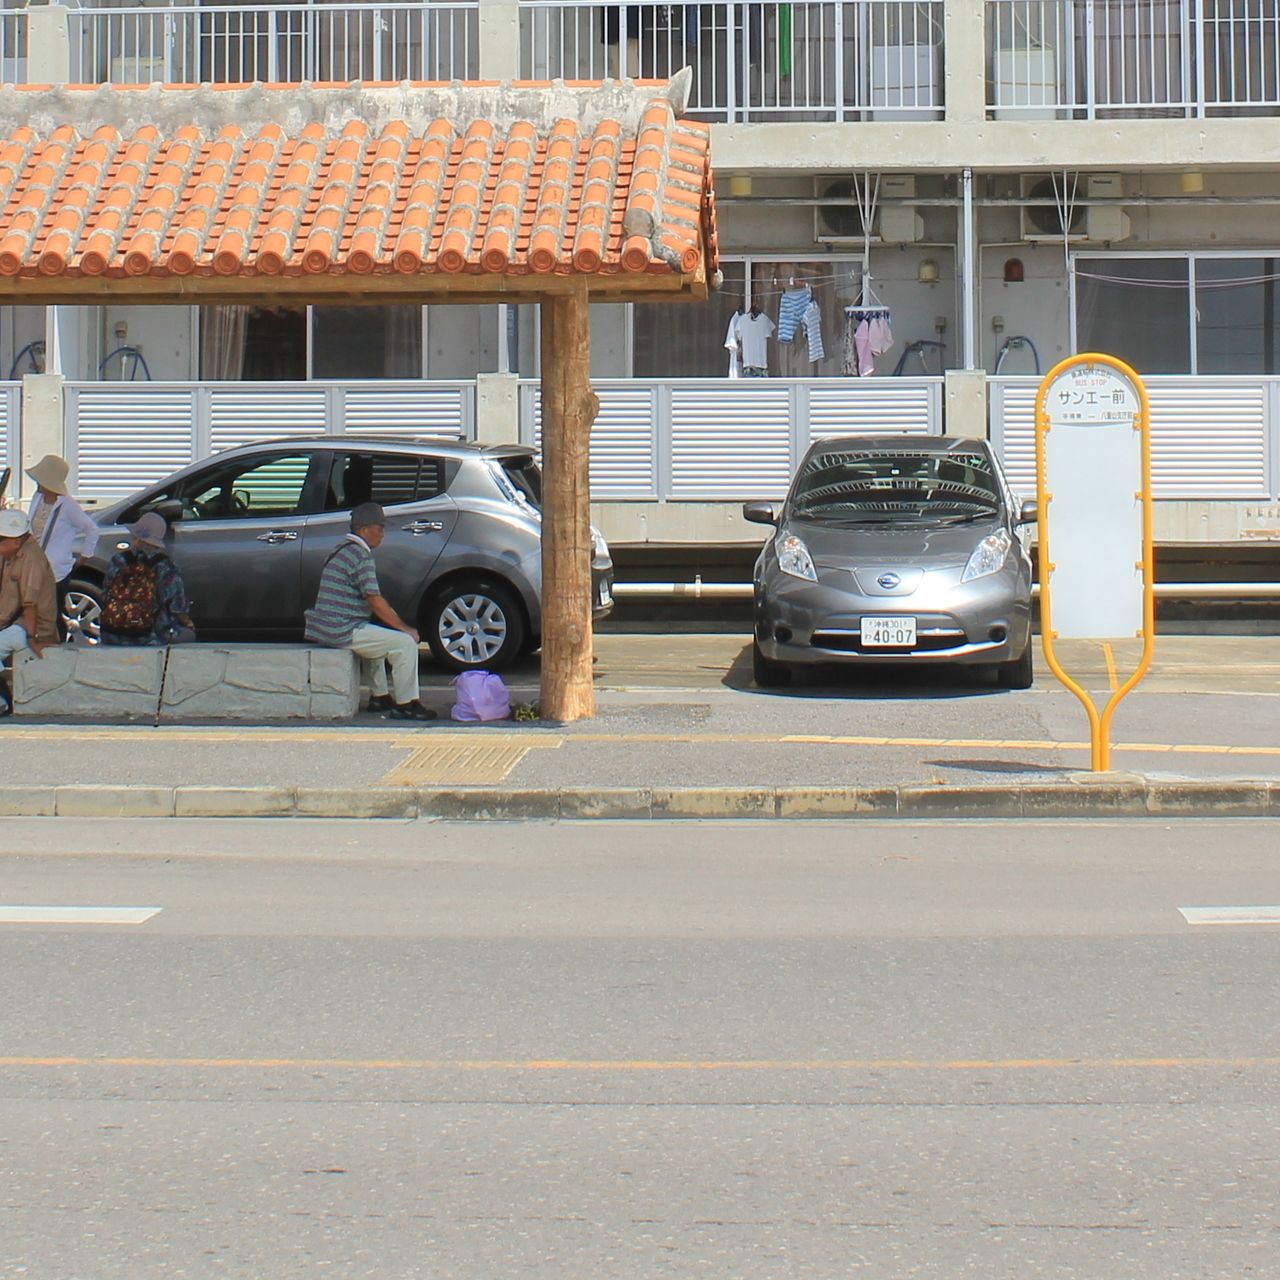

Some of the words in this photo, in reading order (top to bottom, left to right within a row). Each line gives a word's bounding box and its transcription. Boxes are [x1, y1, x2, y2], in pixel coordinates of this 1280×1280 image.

[1091, 379, 1108, 387] STOP
[1058, 389, 1126, 406] サンエー前
[873, 629, 913, 644] 40-07
